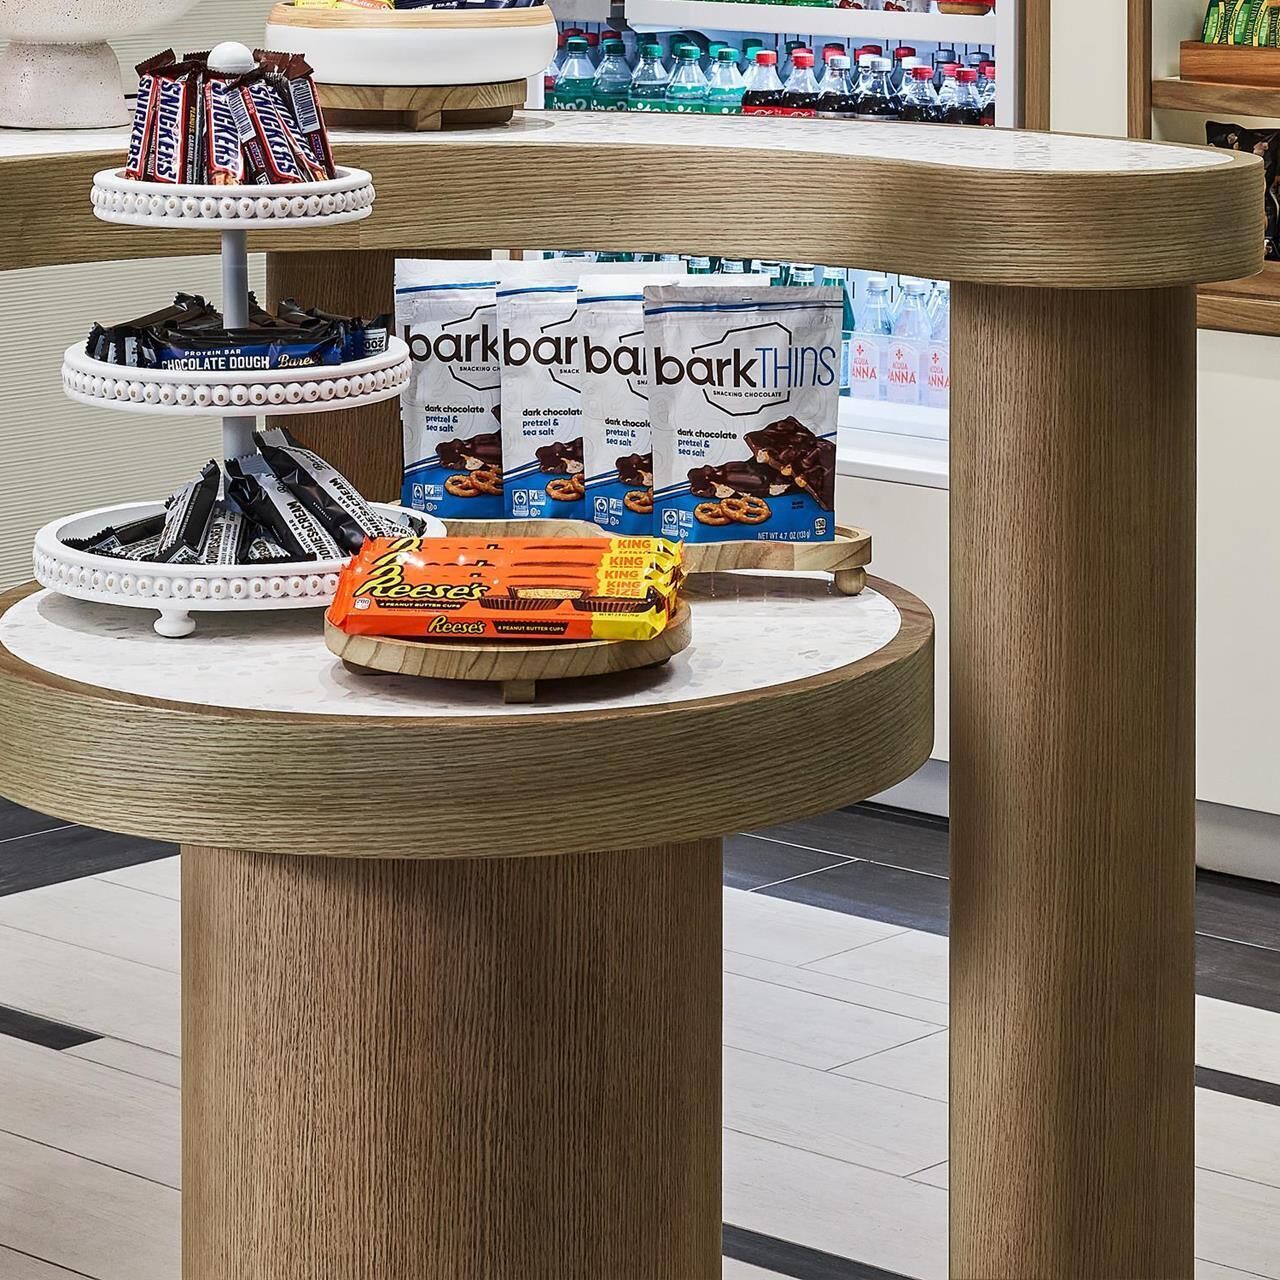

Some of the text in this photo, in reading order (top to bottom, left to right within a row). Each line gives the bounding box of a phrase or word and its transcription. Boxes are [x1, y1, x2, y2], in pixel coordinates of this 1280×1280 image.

[127, 76, 152, 170] SNICKERS
[156, 79, 181, 180] SNICKERS
[249, 85, 300, 178] SNICKERS
[365, 340, 385, 351] 200
[224, 348, 241, 356] BAR
[162, 356, 270, 371] CHOCOLATE DOUGH
[852, 366, 877, 380] ANNA
[712, 390, 742, 398] SNACKING
[424, 404, 485, 414] dark chocolate
[522, 408, 541, 416] dark
[426, 414, 458, 424] pretzel &
[522, 418, 560, 428] pretzel &
[604, 418, 621, 426] dark
[426, 424, 454, 432] sea salt
[538, 428, 554, 436] salt
[606, 428, 636, 438] pretzel &
[676, 428, 738, 440] dark chocolate
[606, 438, 632, 446] sea salt
[678, 438, 710, 448] pretzel &
[678, 448, 705, 457] sea salt
[758, 532, 768, 540] NET
[788, 532, 796, 540] OZ
[618, 540, 651, 549] KING
[610, 556, 644, 566] KING
[604, 570, 638, 579] KING
[352, 574, 491, 600] Reese's
[606, 588, 640, 596] SIZE
[428, 616, 486, 634] Reese's
